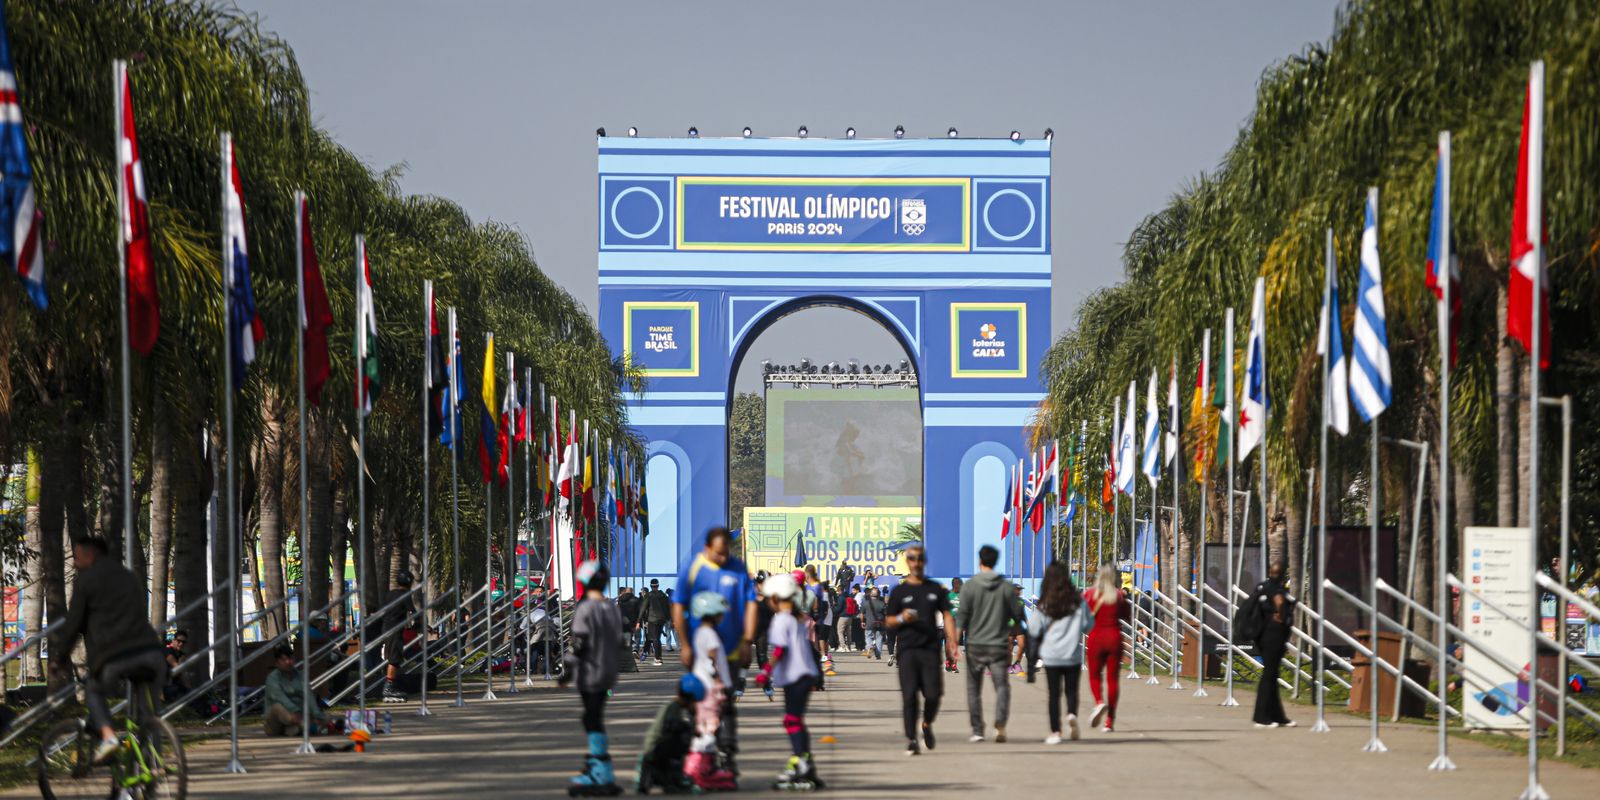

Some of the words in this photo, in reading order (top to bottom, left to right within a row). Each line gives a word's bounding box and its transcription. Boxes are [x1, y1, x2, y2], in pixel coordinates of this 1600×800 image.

[719, 196, 800, 218] FESTIVAL
[804, 194, 891, 219] OLÍMPICO
[807, 222, 843, 235] 2024
[649, 333, 673, 341] TIME
[972, 338, 1006, 347] loterias
[644, 341, 678, 352] BRASIL
[972, 348, 1006, 358] CAIXA
[805, 516, 816, 538] A
[820, 516, 855, 539] FAN
[861, 516, 900, 539] FEST
[805, 540, 839, 562] DOS
[844, 540, 898, 562] JOGOS
